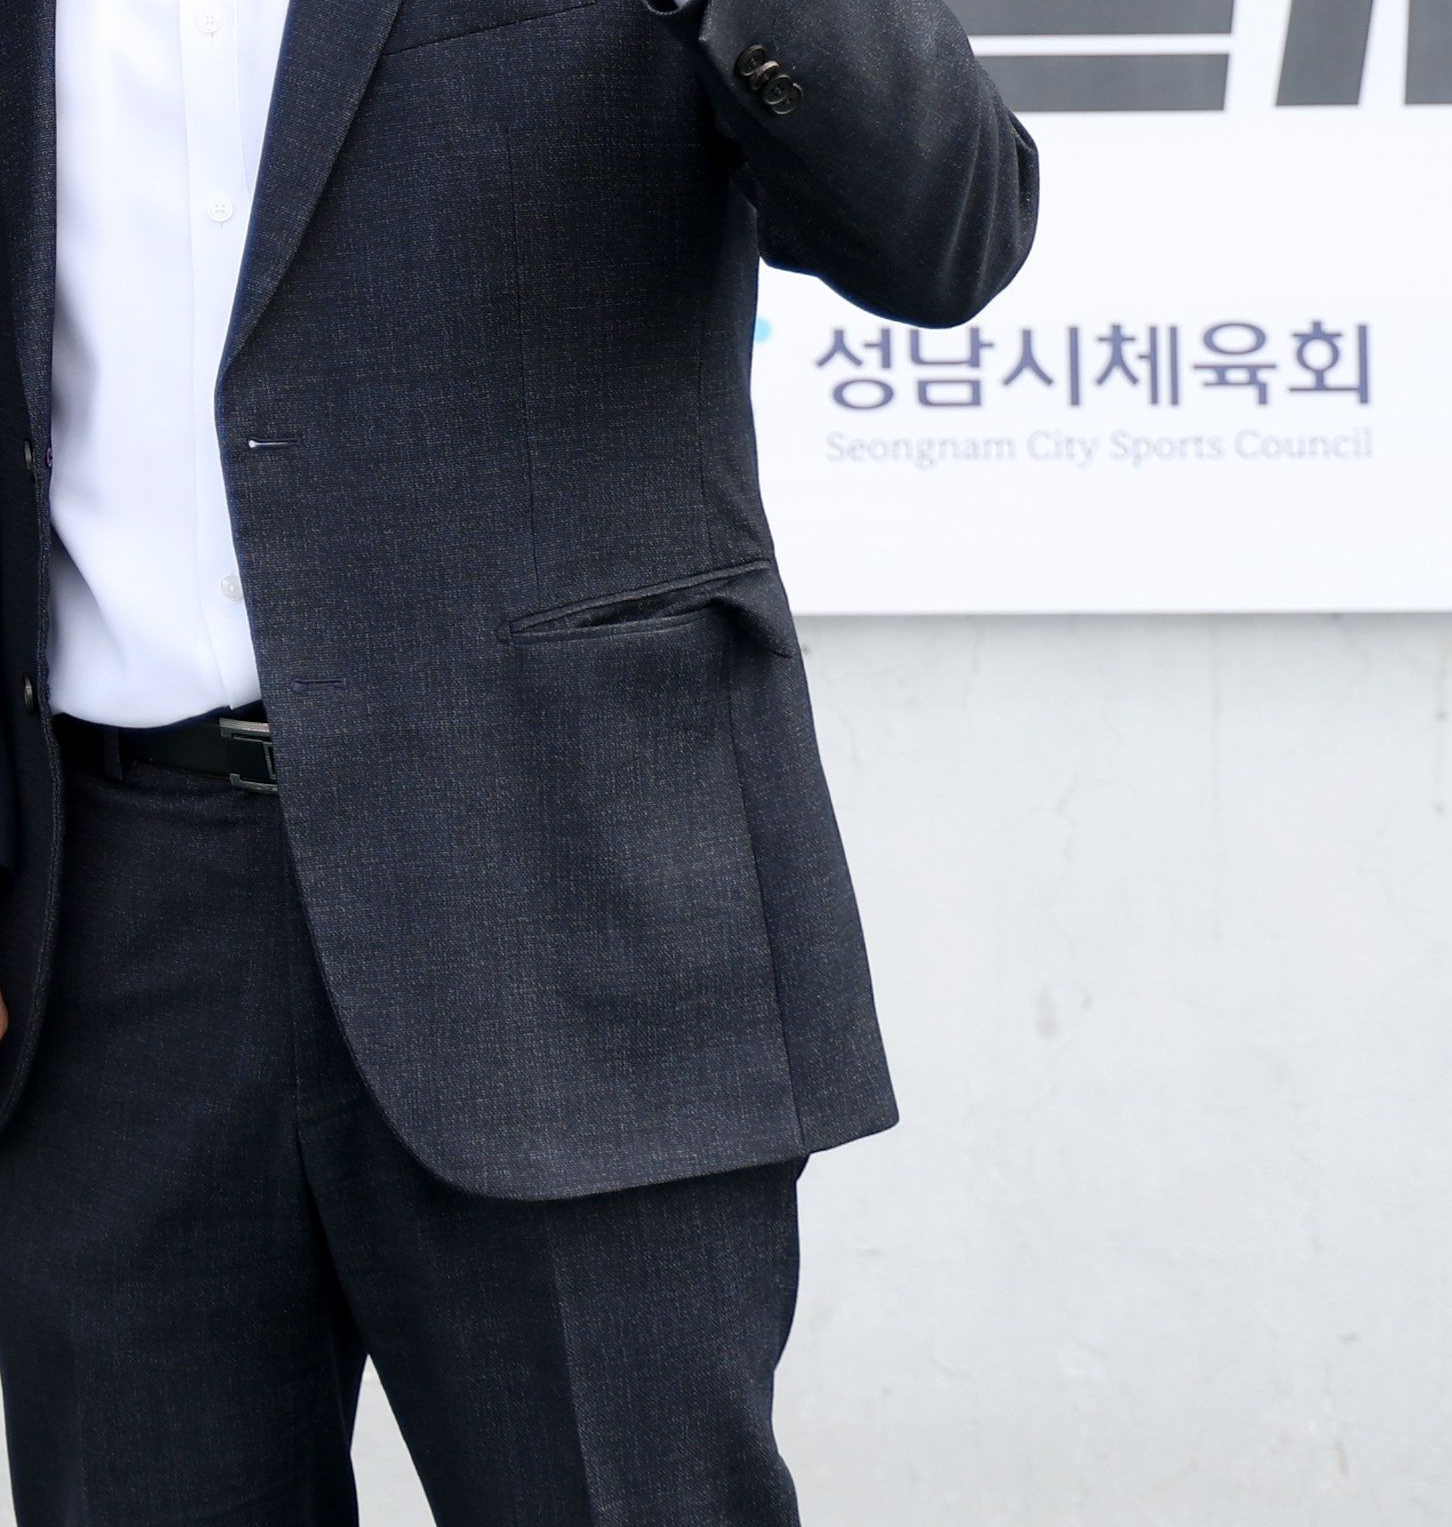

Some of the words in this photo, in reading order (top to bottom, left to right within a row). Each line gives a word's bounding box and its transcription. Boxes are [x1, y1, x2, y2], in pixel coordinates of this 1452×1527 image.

[815, 320, 1372, 410] 성남시체육회
[825, 431, 1017, 469] Seongnam
[1026, 430, 1099, 467] City
[1108, 429, 1224, 466] Sports
[1234, 426, 1374, 461] Council
